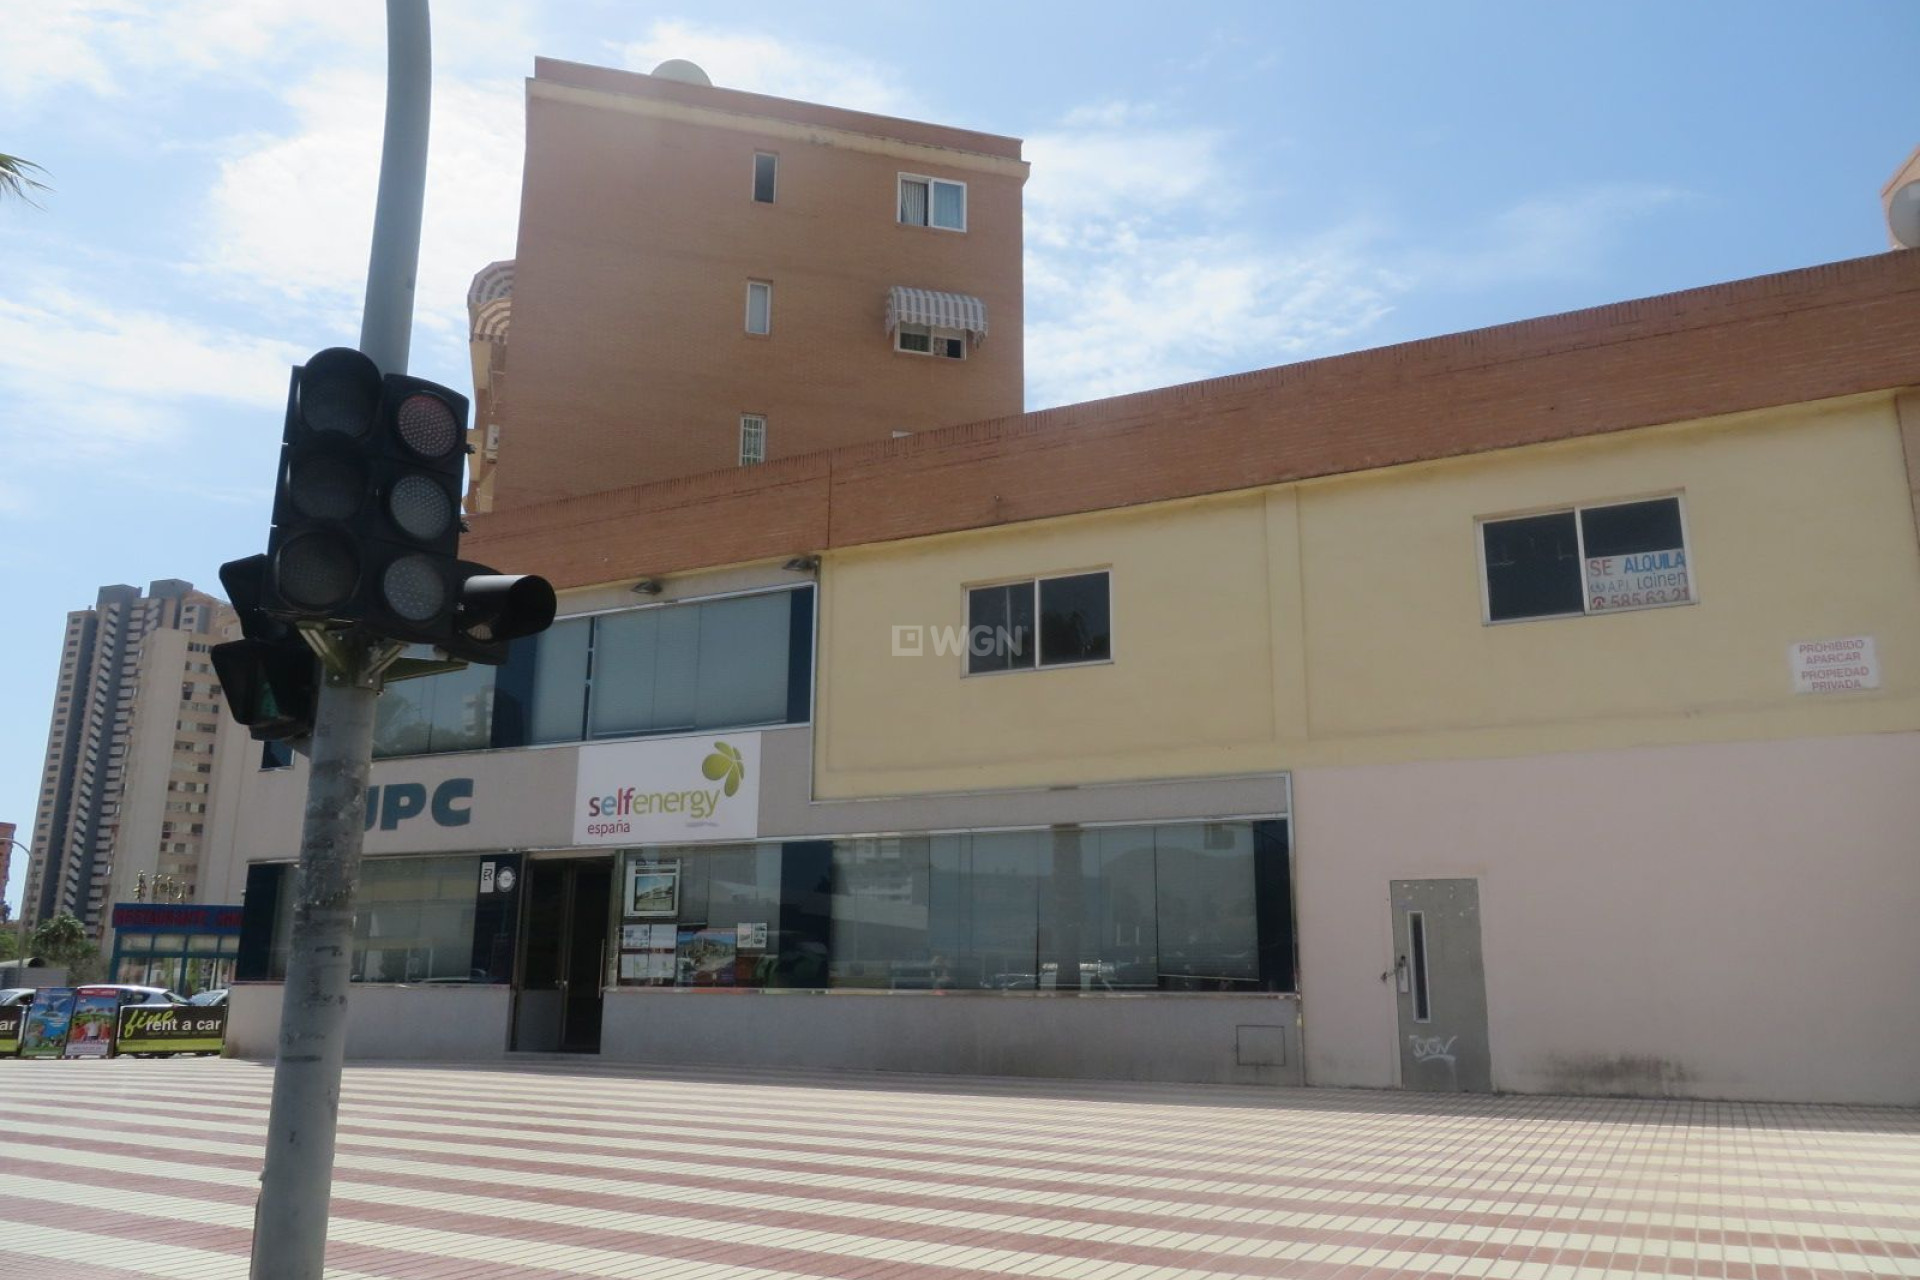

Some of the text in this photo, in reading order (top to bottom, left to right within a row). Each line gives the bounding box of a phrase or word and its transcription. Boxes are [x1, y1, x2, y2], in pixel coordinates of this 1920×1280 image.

[1590, 551, 1686, 577] SE ALQUILA
[1799, 639, 1865, 654] PROHIBIDO
[1806, 651, 1862, 665] APARCAR
[1801, 665, 1870, 681] PROPIEDAD
[1811, 679, 1862, 692] PRIVADA
[587, 819, 630, 837] españa
[0, 1020, 17, 1031] ar
[124, 1009, 174, 1038] fine
[146, 1018, 222, 1031] rent a car
